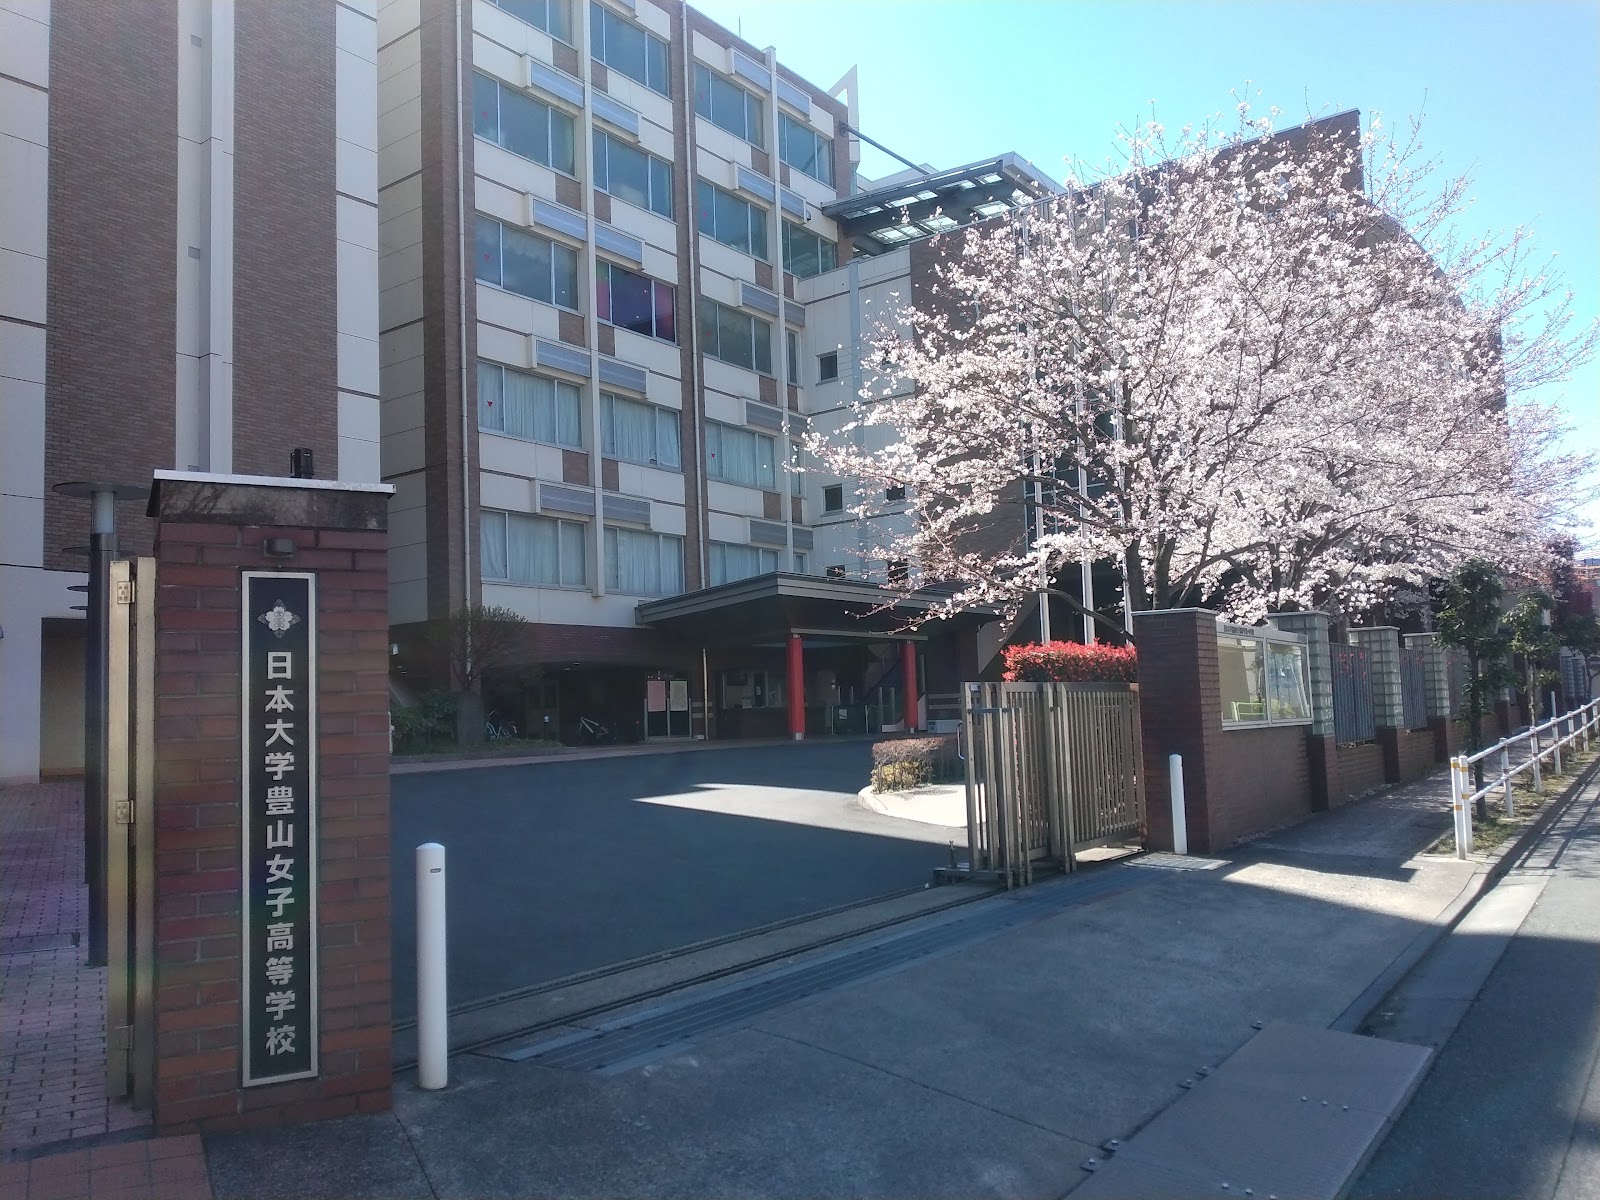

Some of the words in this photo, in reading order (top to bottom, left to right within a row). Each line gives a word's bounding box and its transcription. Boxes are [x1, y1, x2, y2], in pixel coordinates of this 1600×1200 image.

[265, 652, 296, 1056] 日本大学豊山女子高等学校
